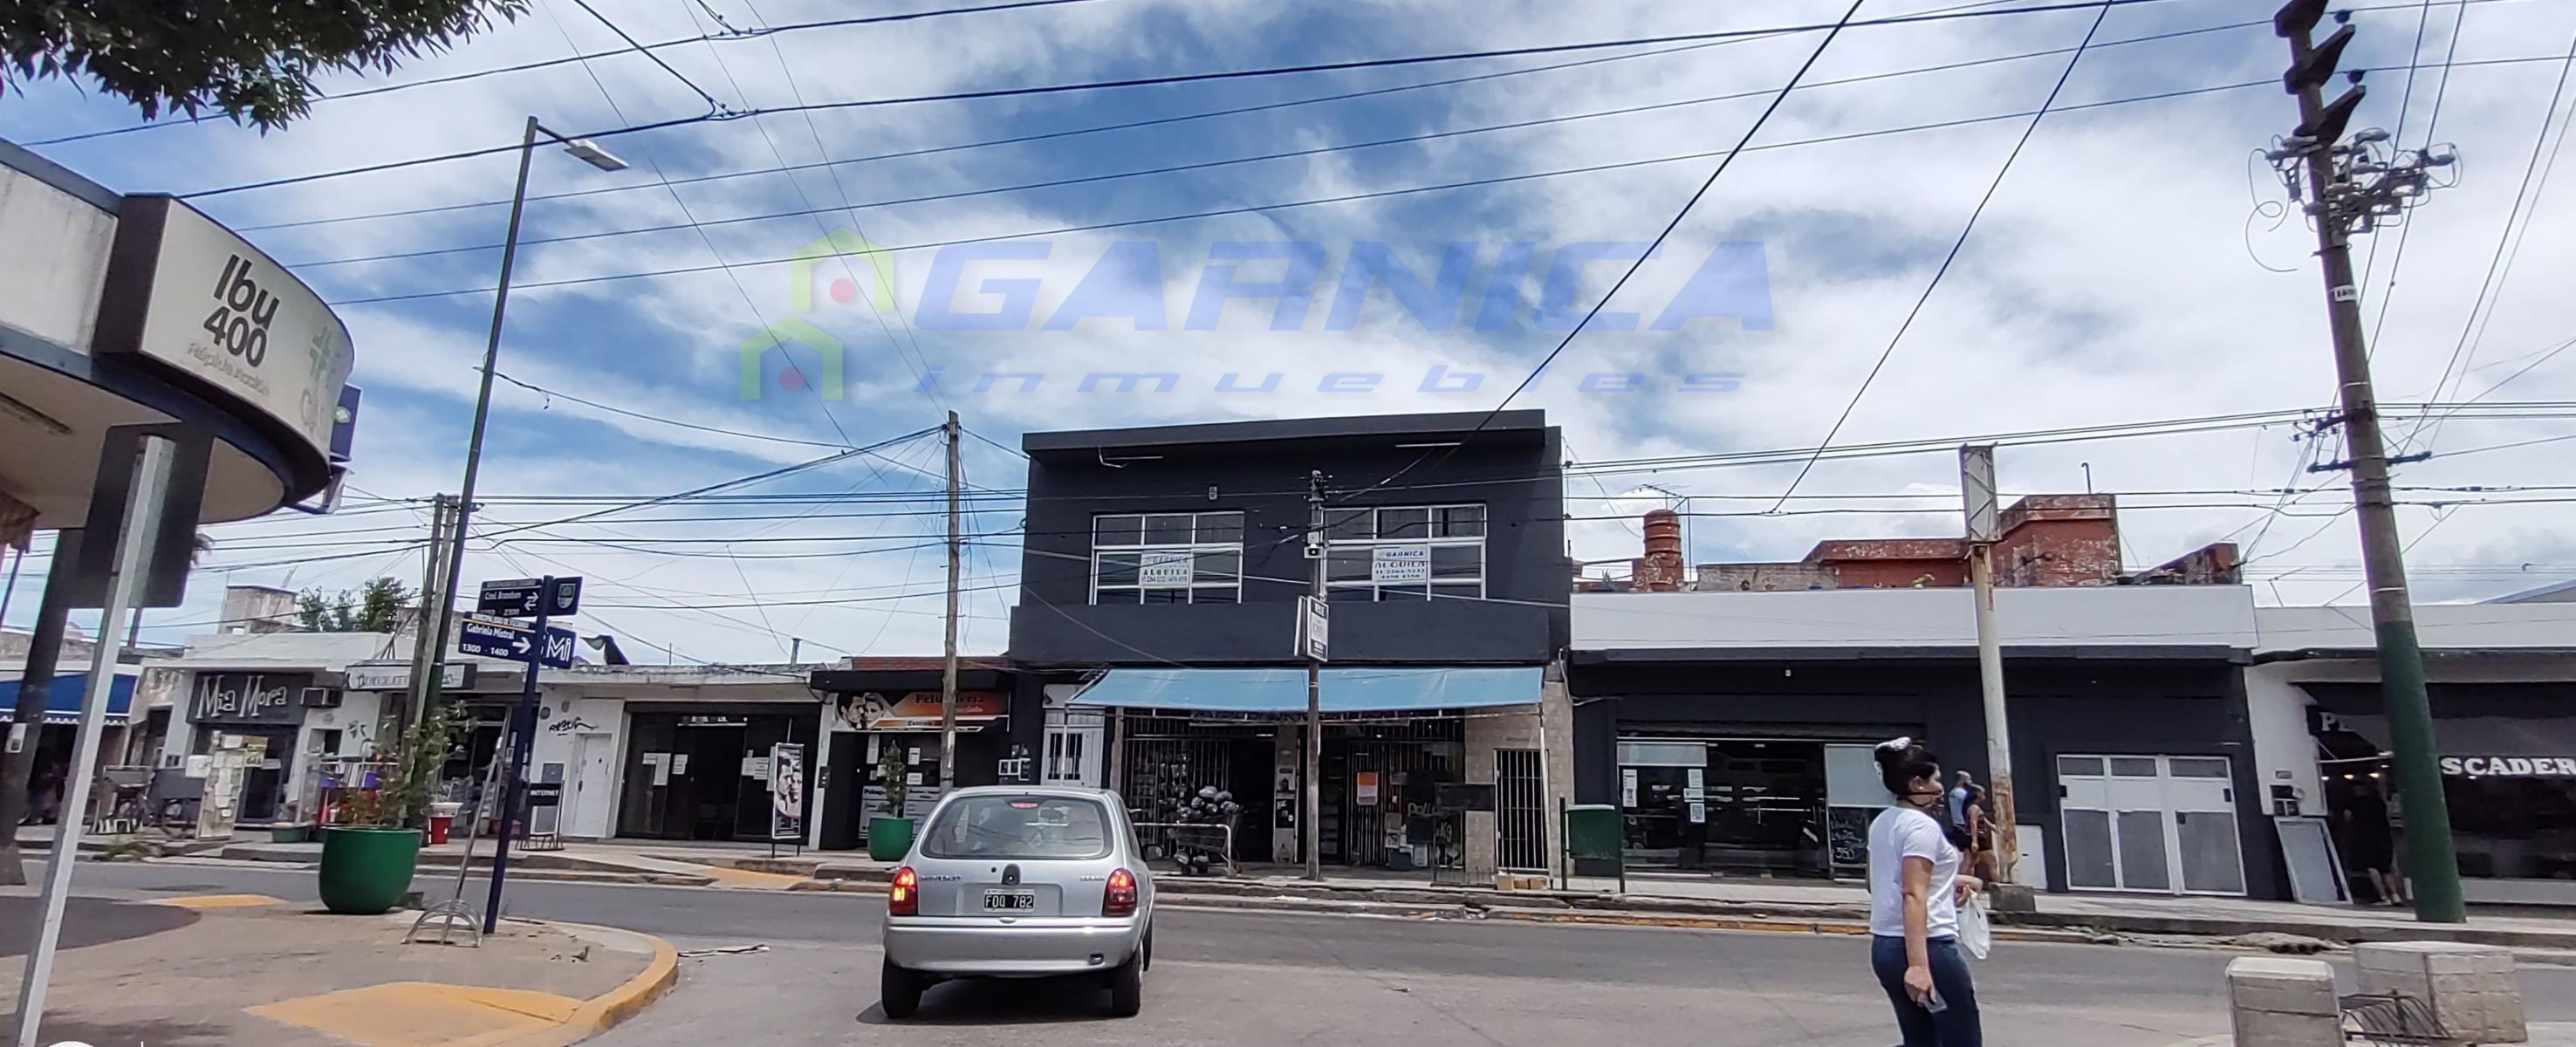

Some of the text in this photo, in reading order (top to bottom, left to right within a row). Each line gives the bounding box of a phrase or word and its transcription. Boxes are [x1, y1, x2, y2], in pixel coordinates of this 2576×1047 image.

[214, 254, 279, 331] Ibu
[203, 305, 268, 367] 400
[462, 643, 482, 653] 1300
[490, 647, 509, 656] 1400
[195, 674, 288, 719] Mia Mora
[1012, 895, 1034, 908] 782
